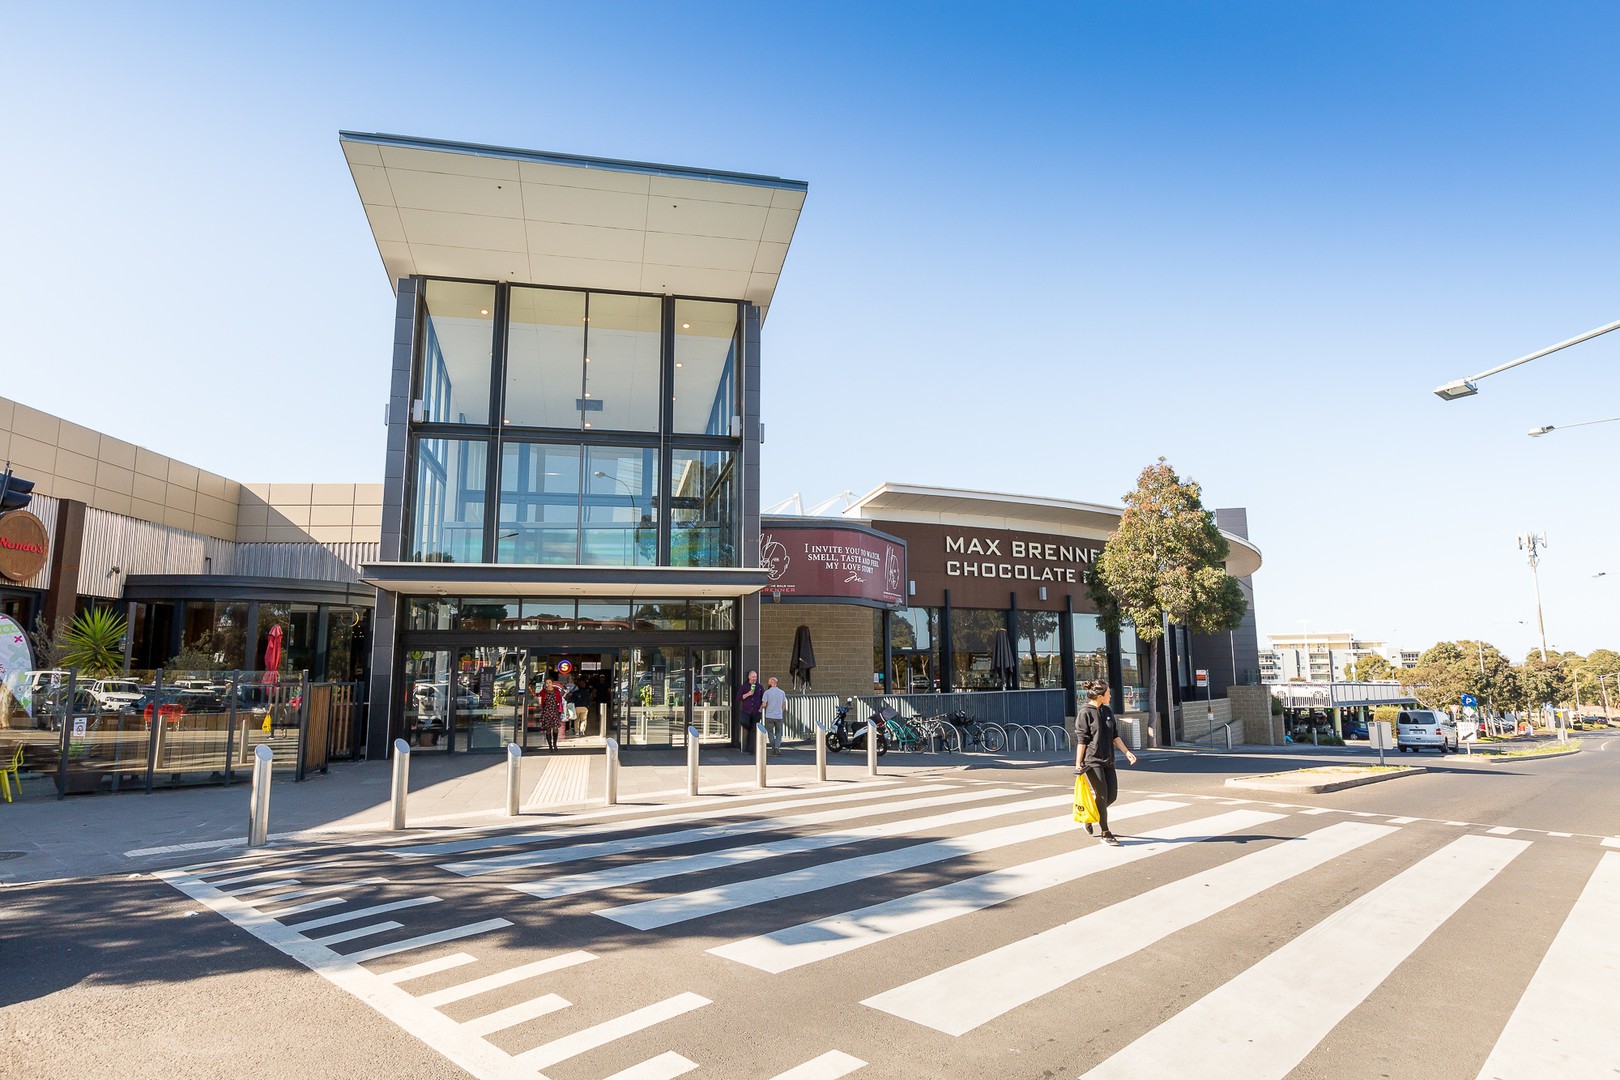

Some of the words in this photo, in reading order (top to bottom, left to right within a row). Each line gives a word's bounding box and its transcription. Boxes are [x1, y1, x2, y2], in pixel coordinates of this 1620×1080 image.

[0, 536, 44, 554] Nando's
[804, 543, 809, 553] I
[811, 545, 843, 554] INVITE
[845, 546, 860, 555] YOU
[946, 535, 1001, 556] MAX
[1011, 540, 1101, 564] BRENNE
[807, 553, 839, 562] SMELL,
[840, 554, 861, 563] TASTE
[825, 562, 839, 570] MY
[842, 562, 861, 571] LOVE
[946, 560, 1076, 583] CHOCOLATE
